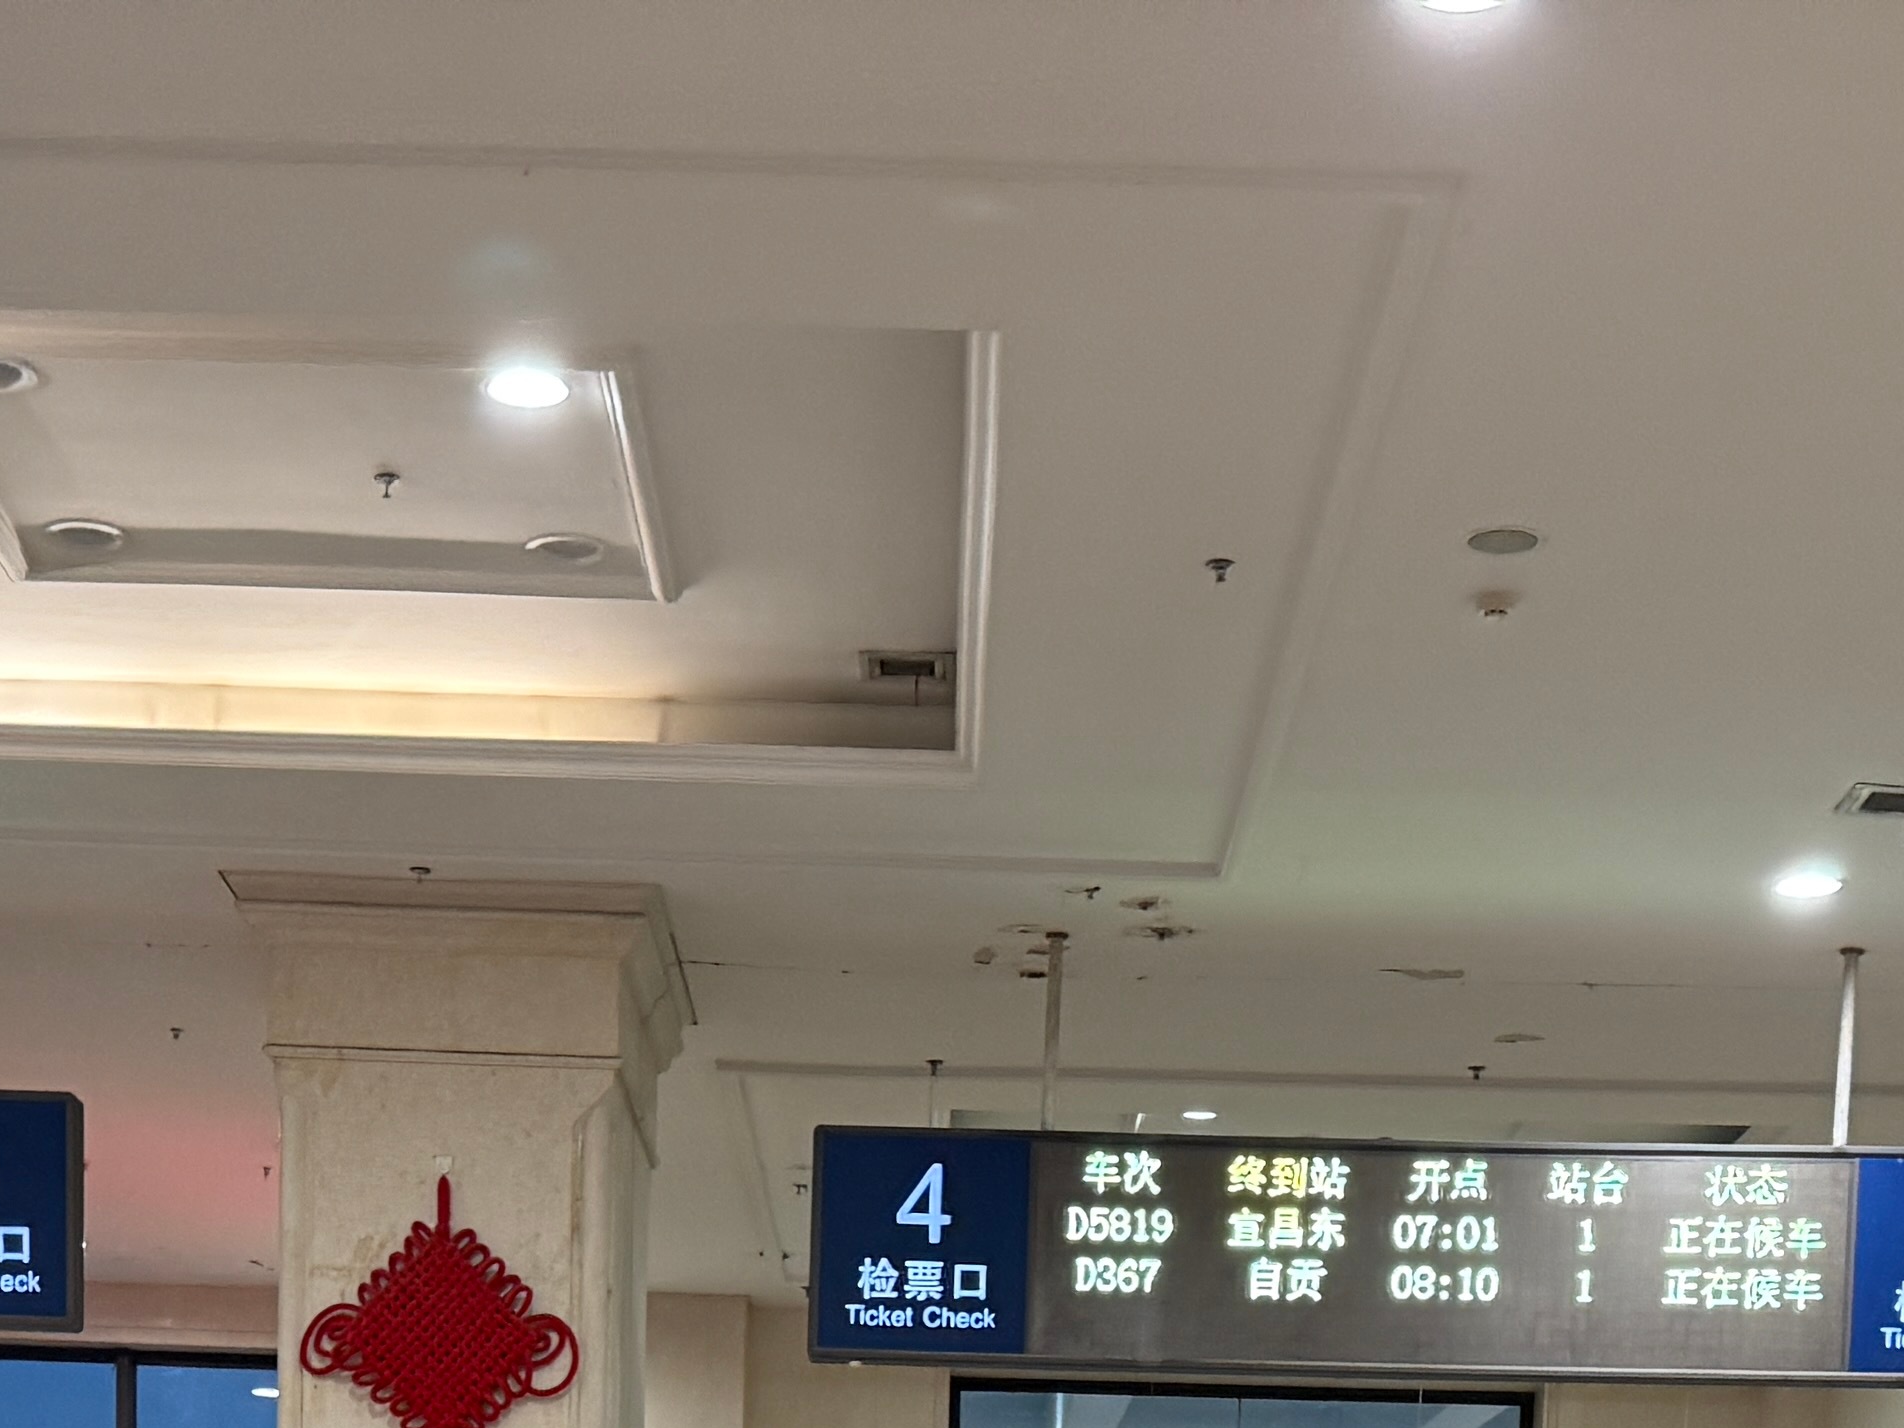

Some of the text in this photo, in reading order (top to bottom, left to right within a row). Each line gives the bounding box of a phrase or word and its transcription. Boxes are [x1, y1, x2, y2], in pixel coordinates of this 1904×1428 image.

[1081, 1150, 1162, 1196] 车次
[1226, 1154, 1348, 1200] 终到站
[1408, 1158, 1489, 1202] 开点
[1547, 1160, 1629, 1206] 站台
[1704, 1162, 1788, 1207] 状态
[896, 1162, 952, 1244] 4
[1065, 1207, 1173, 1243] D5819
[1227, 1207, 1346, 1250] 宜昌东
[1393, 1214, 1499, 1251] 07:01
[1578, 1219, 1595, 1253] 1
[1662, 1216, 1826, 1258] 正在候车
[857, 1257, 988, 1301] 检票口
[1075, 1257, 1162, 1293] D367
[1248, 1258, 1328, 1302] 自贡
[1389, 1264, 1499, 1303] 08:10
[1576, 1270, 1593, 1303] 1
[1661, 1267, 1824, 1310] 正在候车
[845, 1304, 996, 1329] Ticket Check
